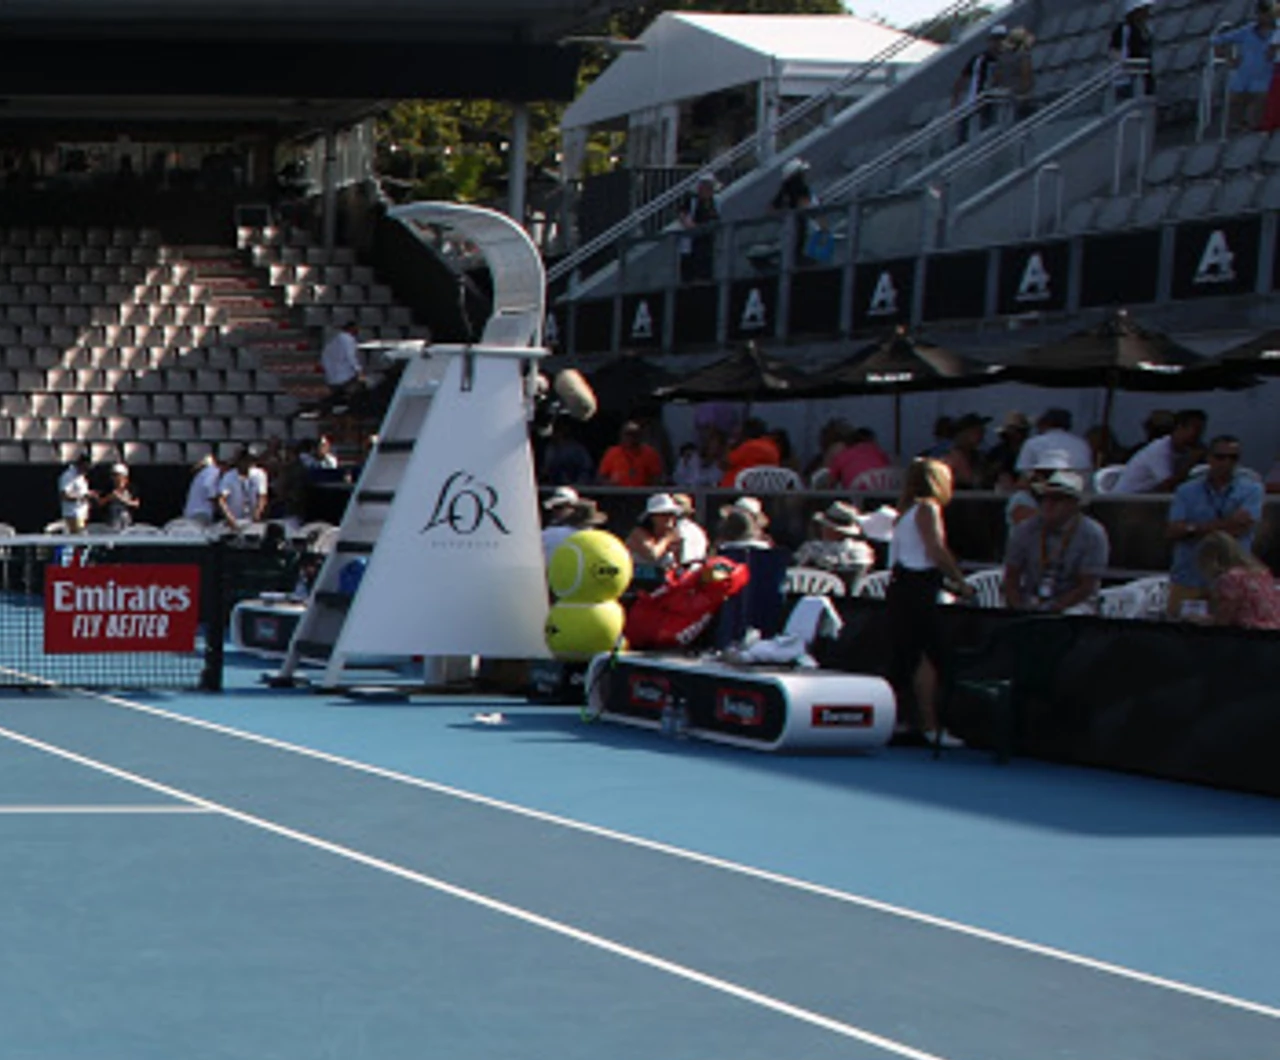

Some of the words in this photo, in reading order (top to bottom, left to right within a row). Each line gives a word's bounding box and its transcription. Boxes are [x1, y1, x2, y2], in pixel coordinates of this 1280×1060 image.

[52, 579, 192, 612] Emirates
[72, 613, 103, 639] FLY
[105, 613, 171, 639] BETTER
